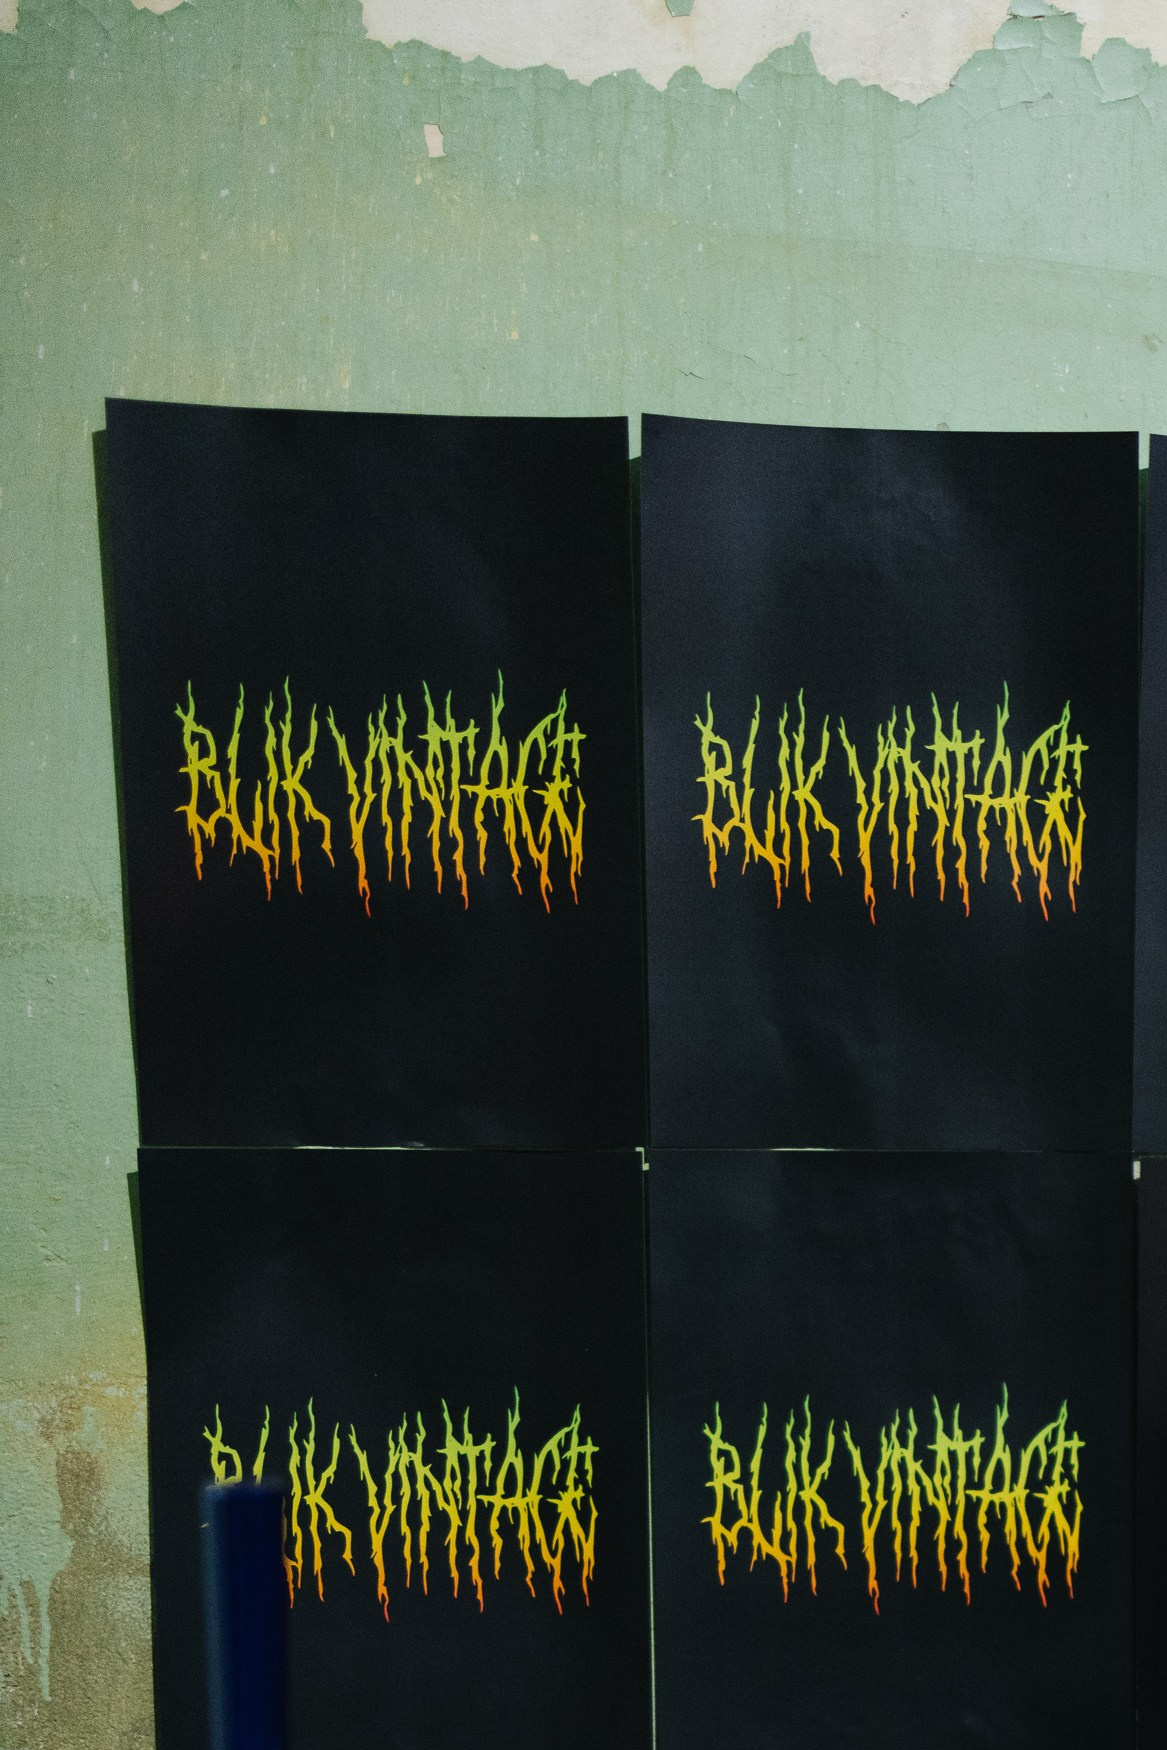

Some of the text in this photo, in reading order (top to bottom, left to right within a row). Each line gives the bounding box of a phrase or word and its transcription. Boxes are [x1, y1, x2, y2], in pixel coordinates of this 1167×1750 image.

[175, 670, 587, 918] BLIK VINTAGE
[692, 682, 1089, 925] BLIK VINTAGE
[348, 1386, 599, 1623] VINTAGE
[700, 1395, 847, 1603] BLIK
[842, 1383, 1087, 1616] VINTAGE
